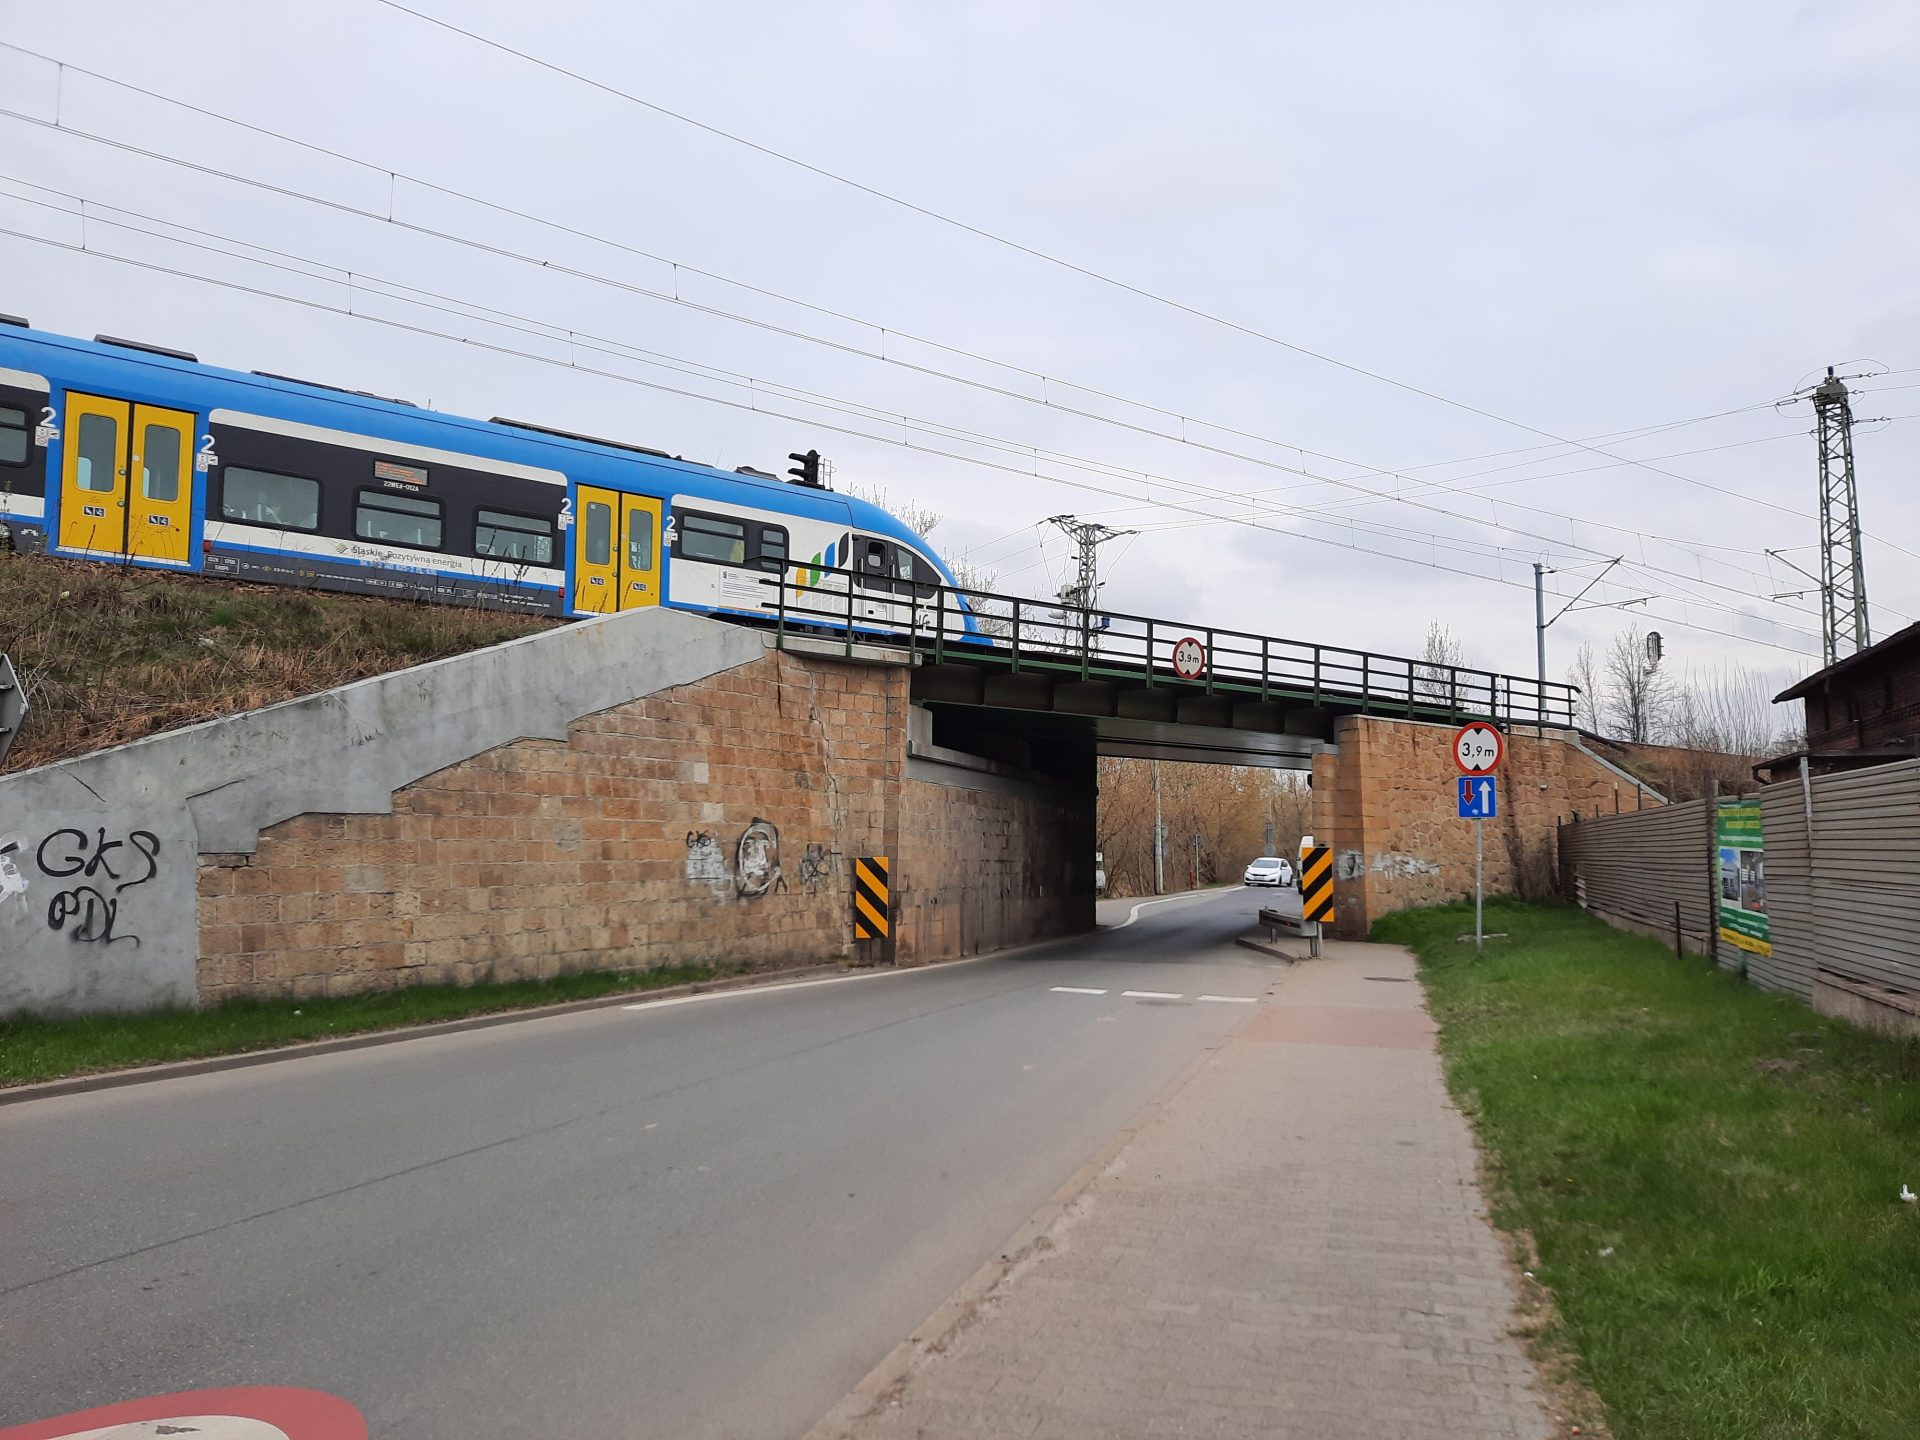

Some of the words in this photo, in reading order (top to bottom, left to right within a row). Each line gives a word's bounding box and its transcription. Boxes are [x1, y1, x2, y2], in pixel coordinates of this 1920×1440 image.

[40, 406, 57, 428] 2
[200, 434, 216, 454] 2
[560, 497, 572, 515] 2
[666, 515, 677, 532] 2
[432, 558, 463, 569] energia
[37, 827, 160, 892] GKS
